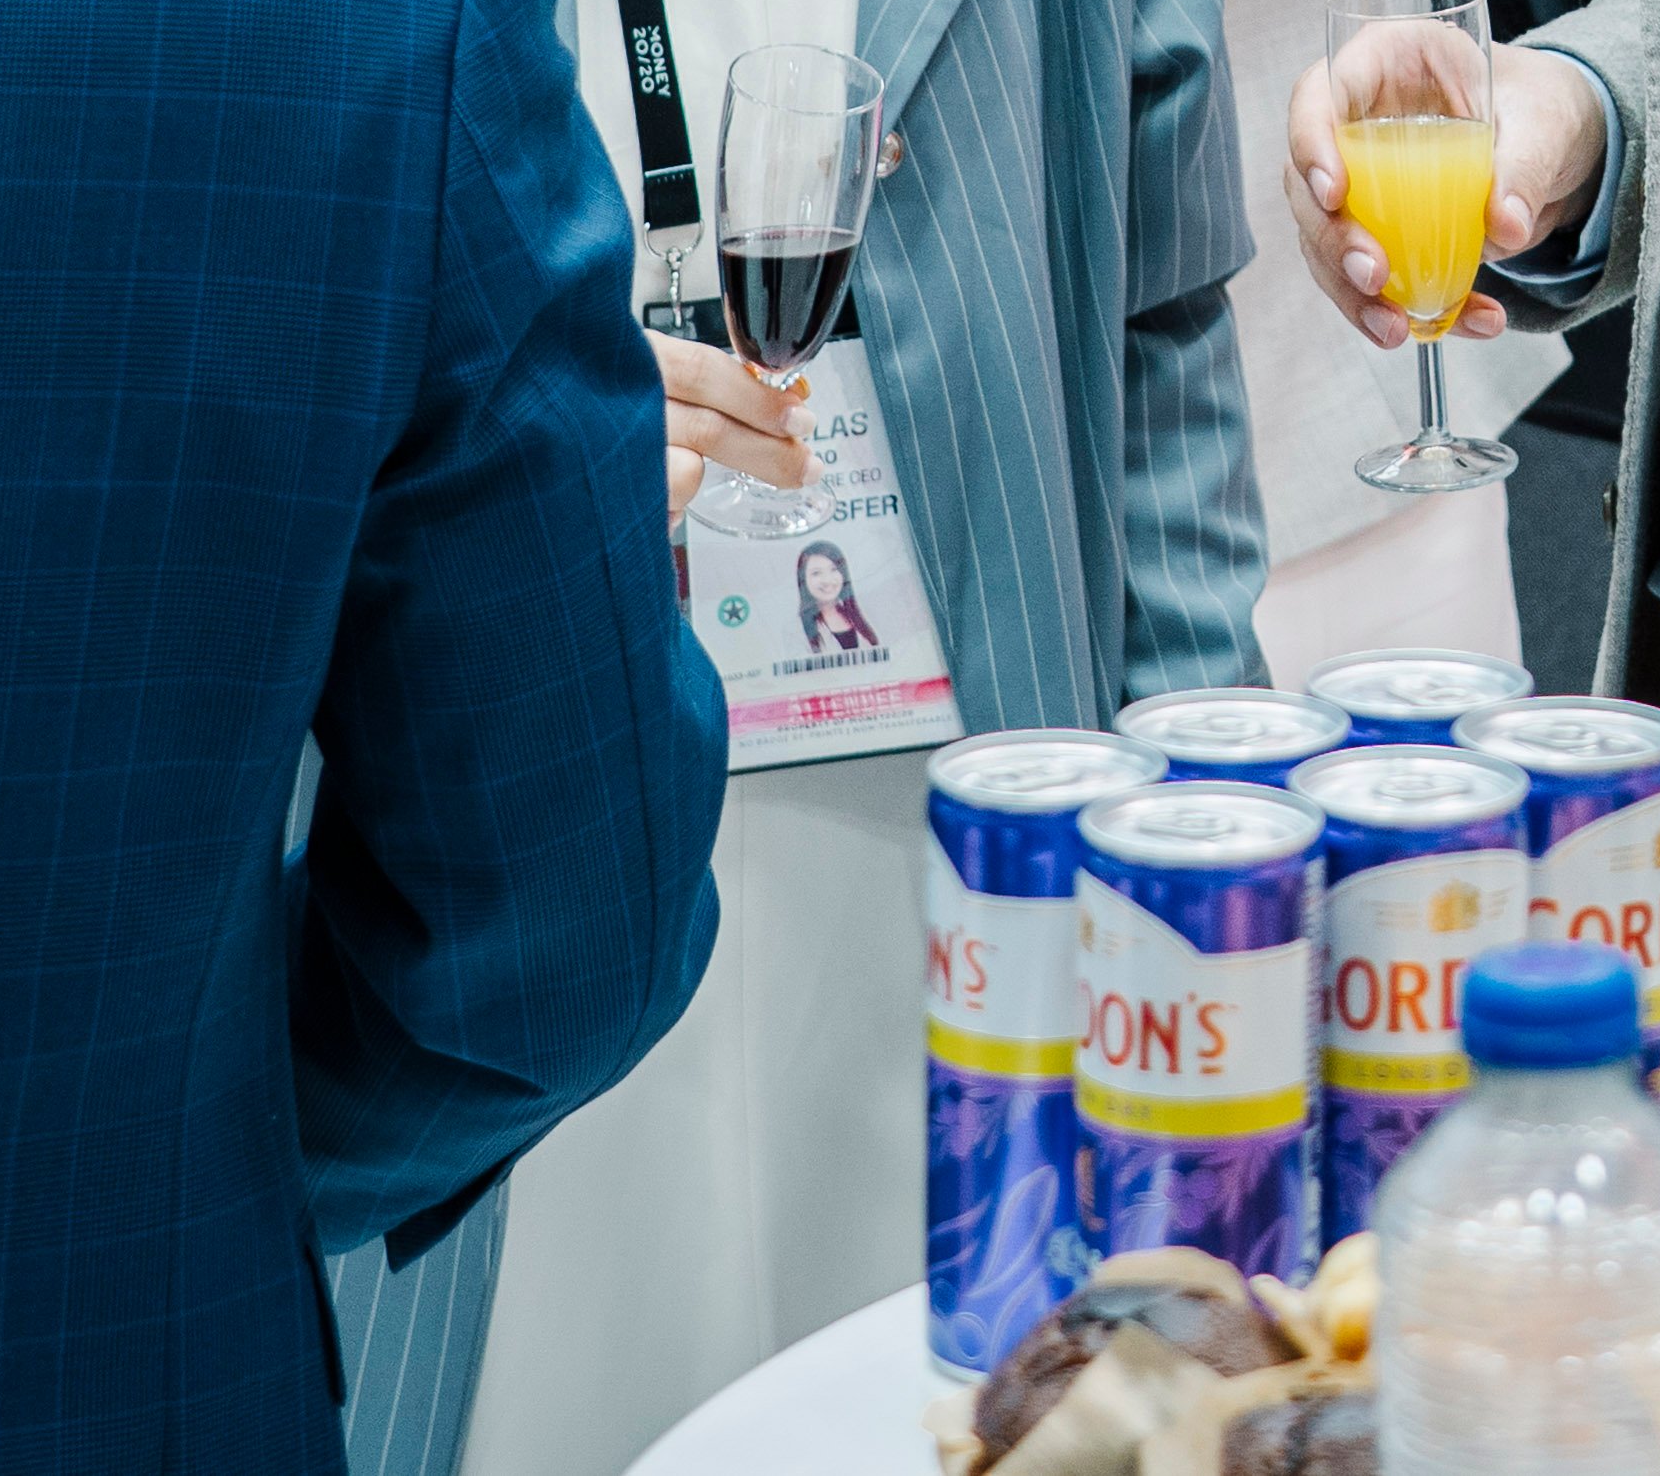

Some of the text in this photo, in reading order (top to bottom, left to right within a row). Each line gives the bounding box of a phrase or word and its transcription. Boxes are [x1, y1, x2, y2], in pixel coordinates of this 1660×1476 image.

[633, 26, 655, 94] 20/20
[647, 25, 671, 98] MONEY
[849, 467, 881, 484] CEO
